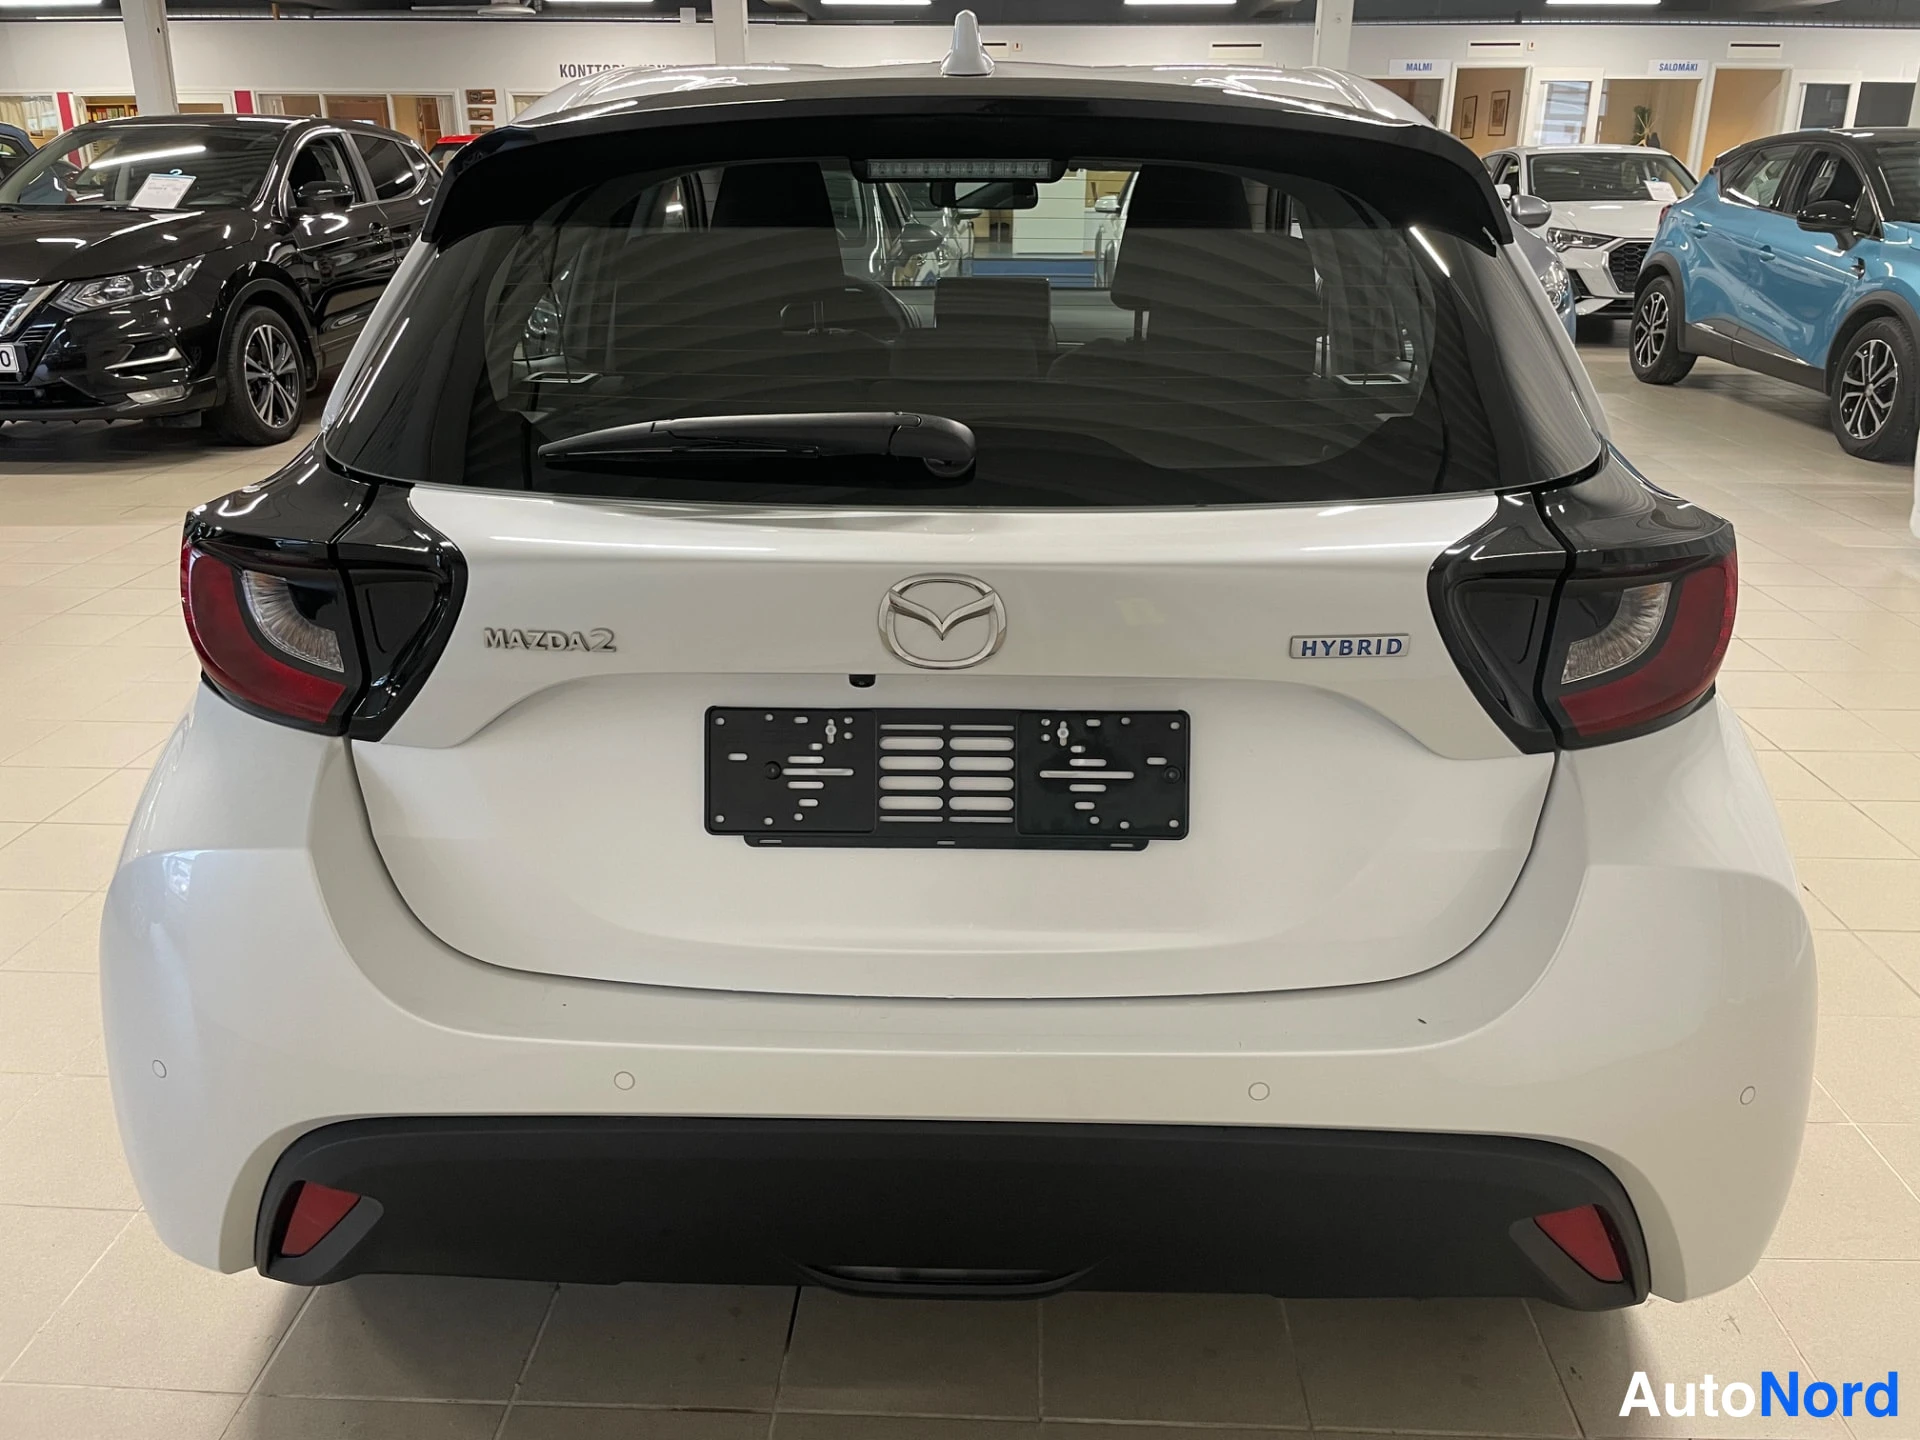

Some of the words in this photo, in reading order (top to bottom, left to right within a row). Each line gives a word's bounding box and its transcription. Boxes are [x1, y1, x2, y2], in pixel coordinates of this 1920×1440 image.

[1406, 62, 1433, 72] MALMI
[1659, 61, 1698, 72] SALOMÄKI
[1301, 638, 1403, 657] HYBRID
